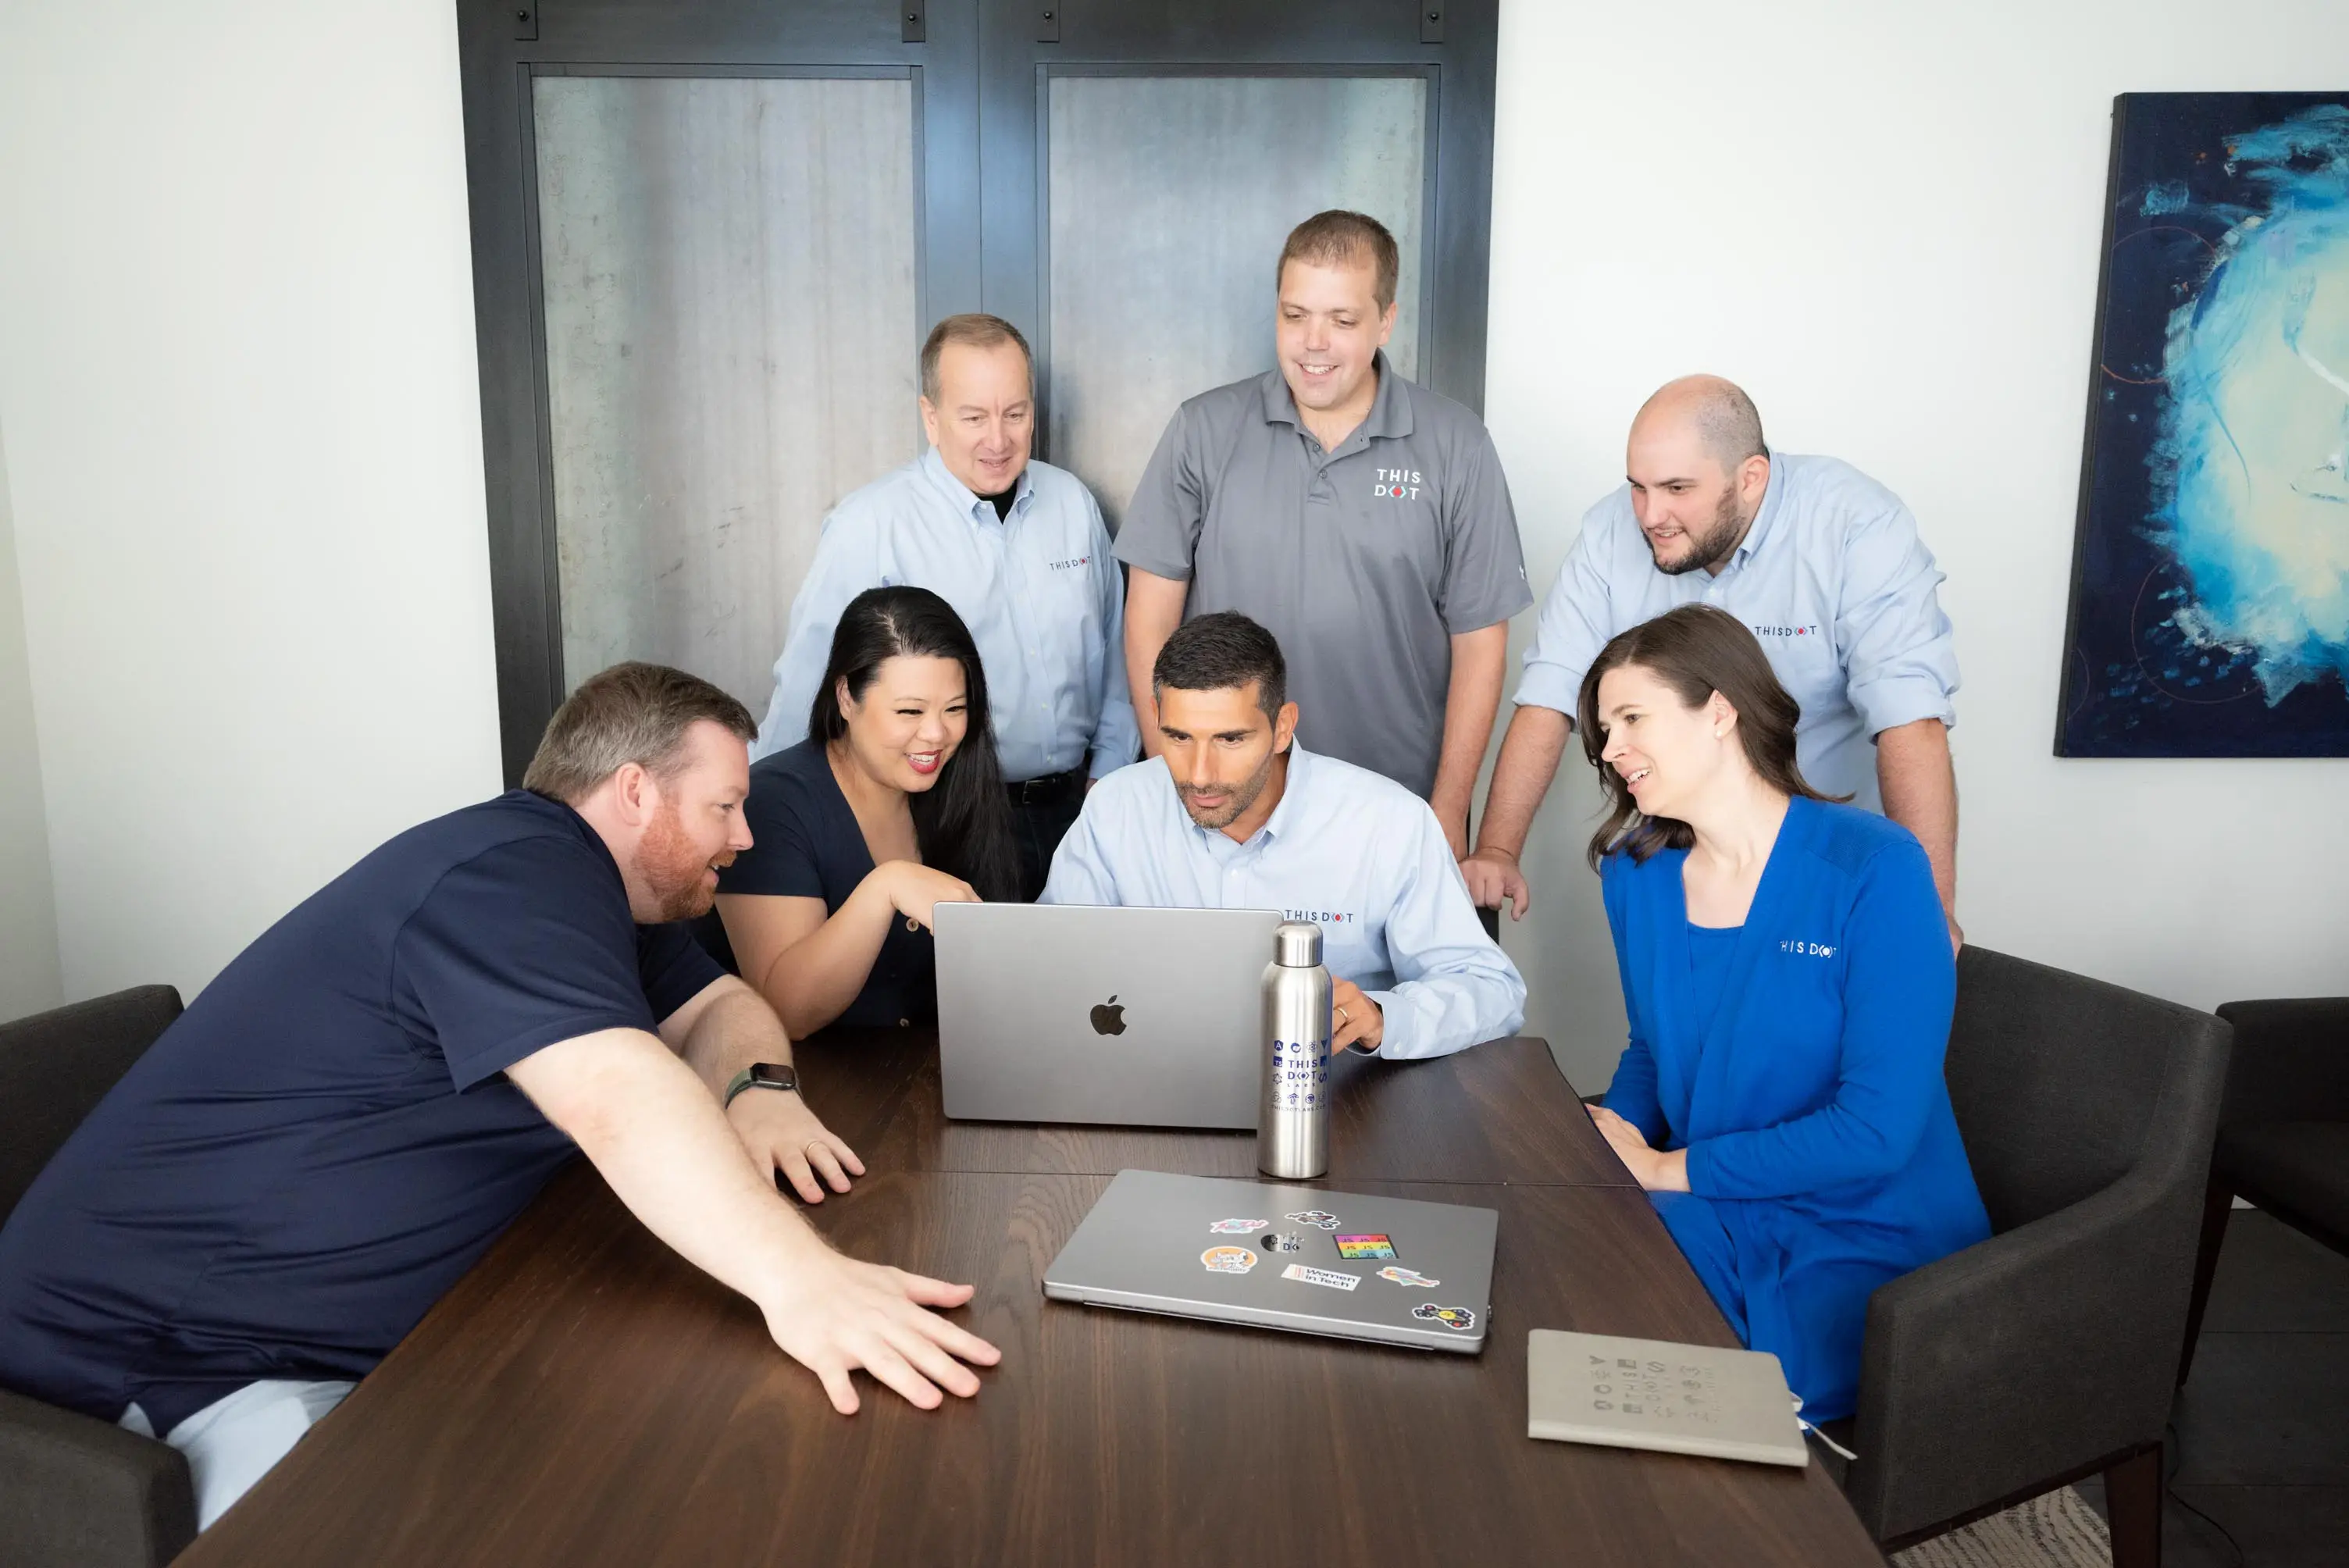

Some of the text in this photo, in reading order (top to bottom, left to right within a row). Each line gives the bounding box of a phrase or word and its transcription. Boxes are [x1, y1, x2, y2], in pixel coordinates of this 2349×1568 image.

[1377, 469, 1420, 484] THIS
[1288, 1059, 1318, 1069] THIS
[1306, 1269, 1356, 1282] Women
[1320, 1277, 1349, 1288] Tech
